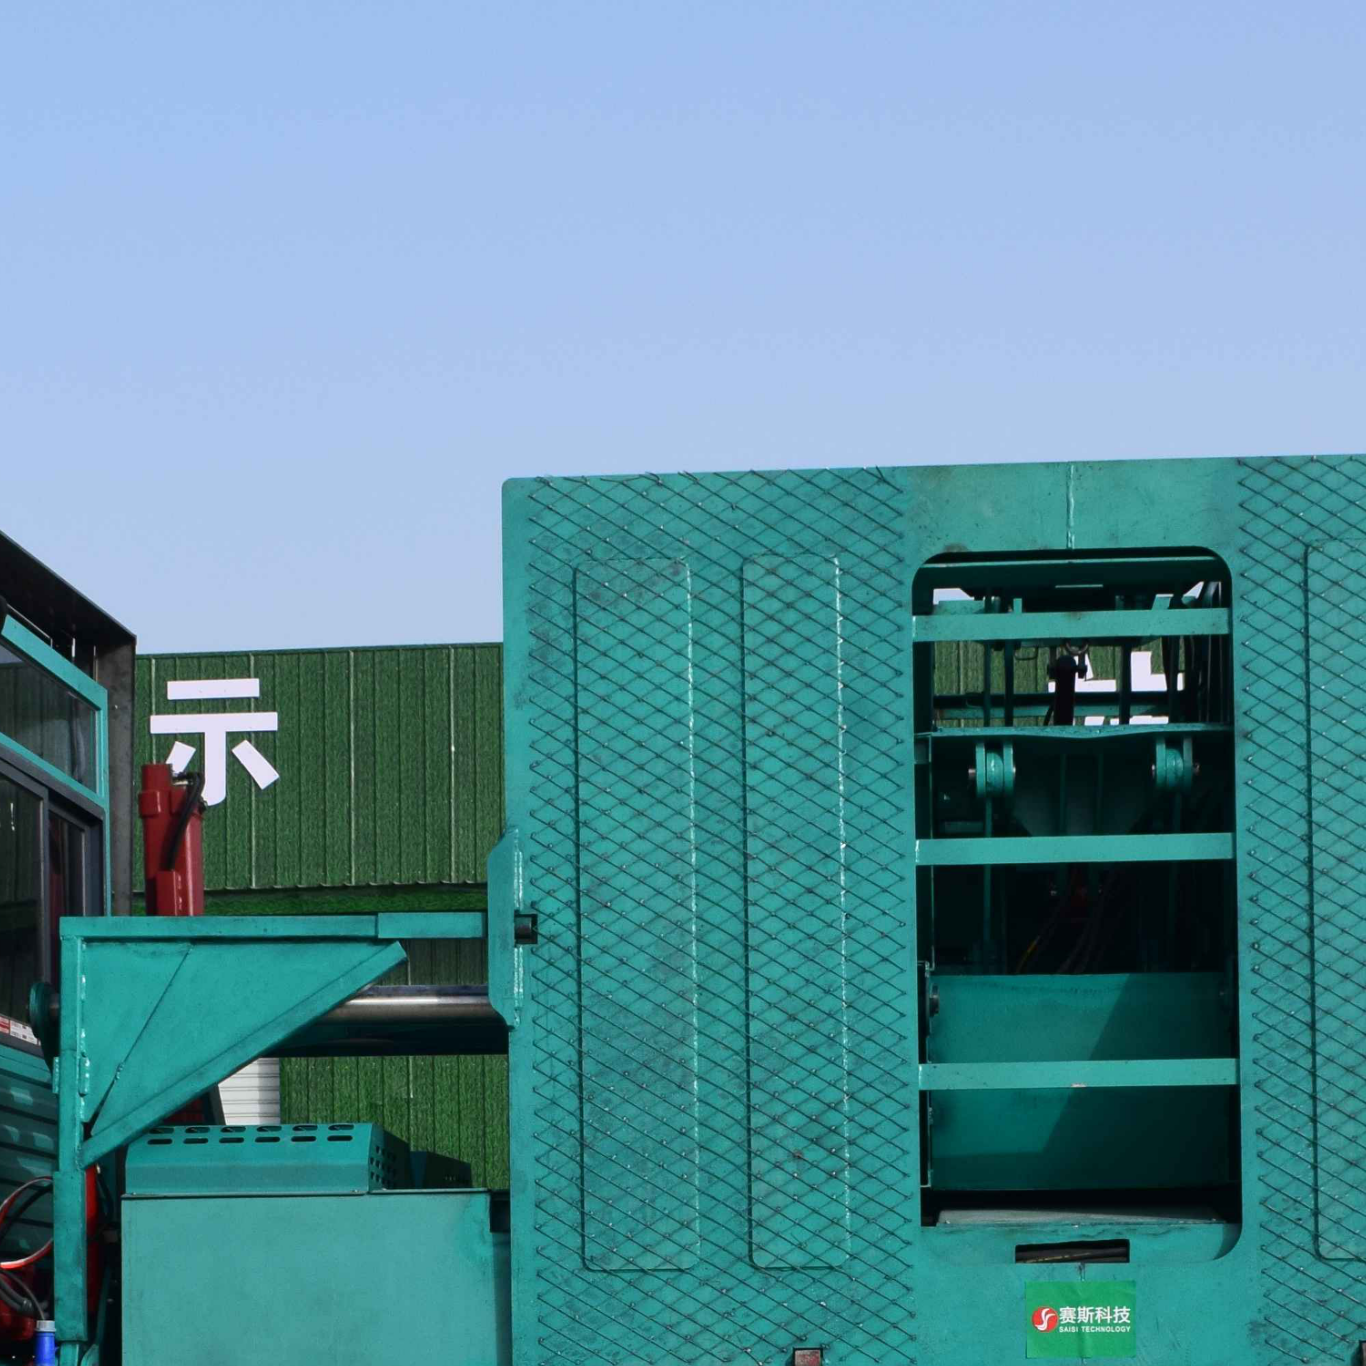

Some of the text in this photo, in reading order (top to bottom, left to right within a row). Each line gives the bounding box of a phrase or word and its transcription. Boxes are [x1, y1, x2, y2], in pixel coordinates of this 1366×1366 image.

[150, 678, 280, 806] 示
[1059, 1306, 1131, 1324] 赛斯科技
